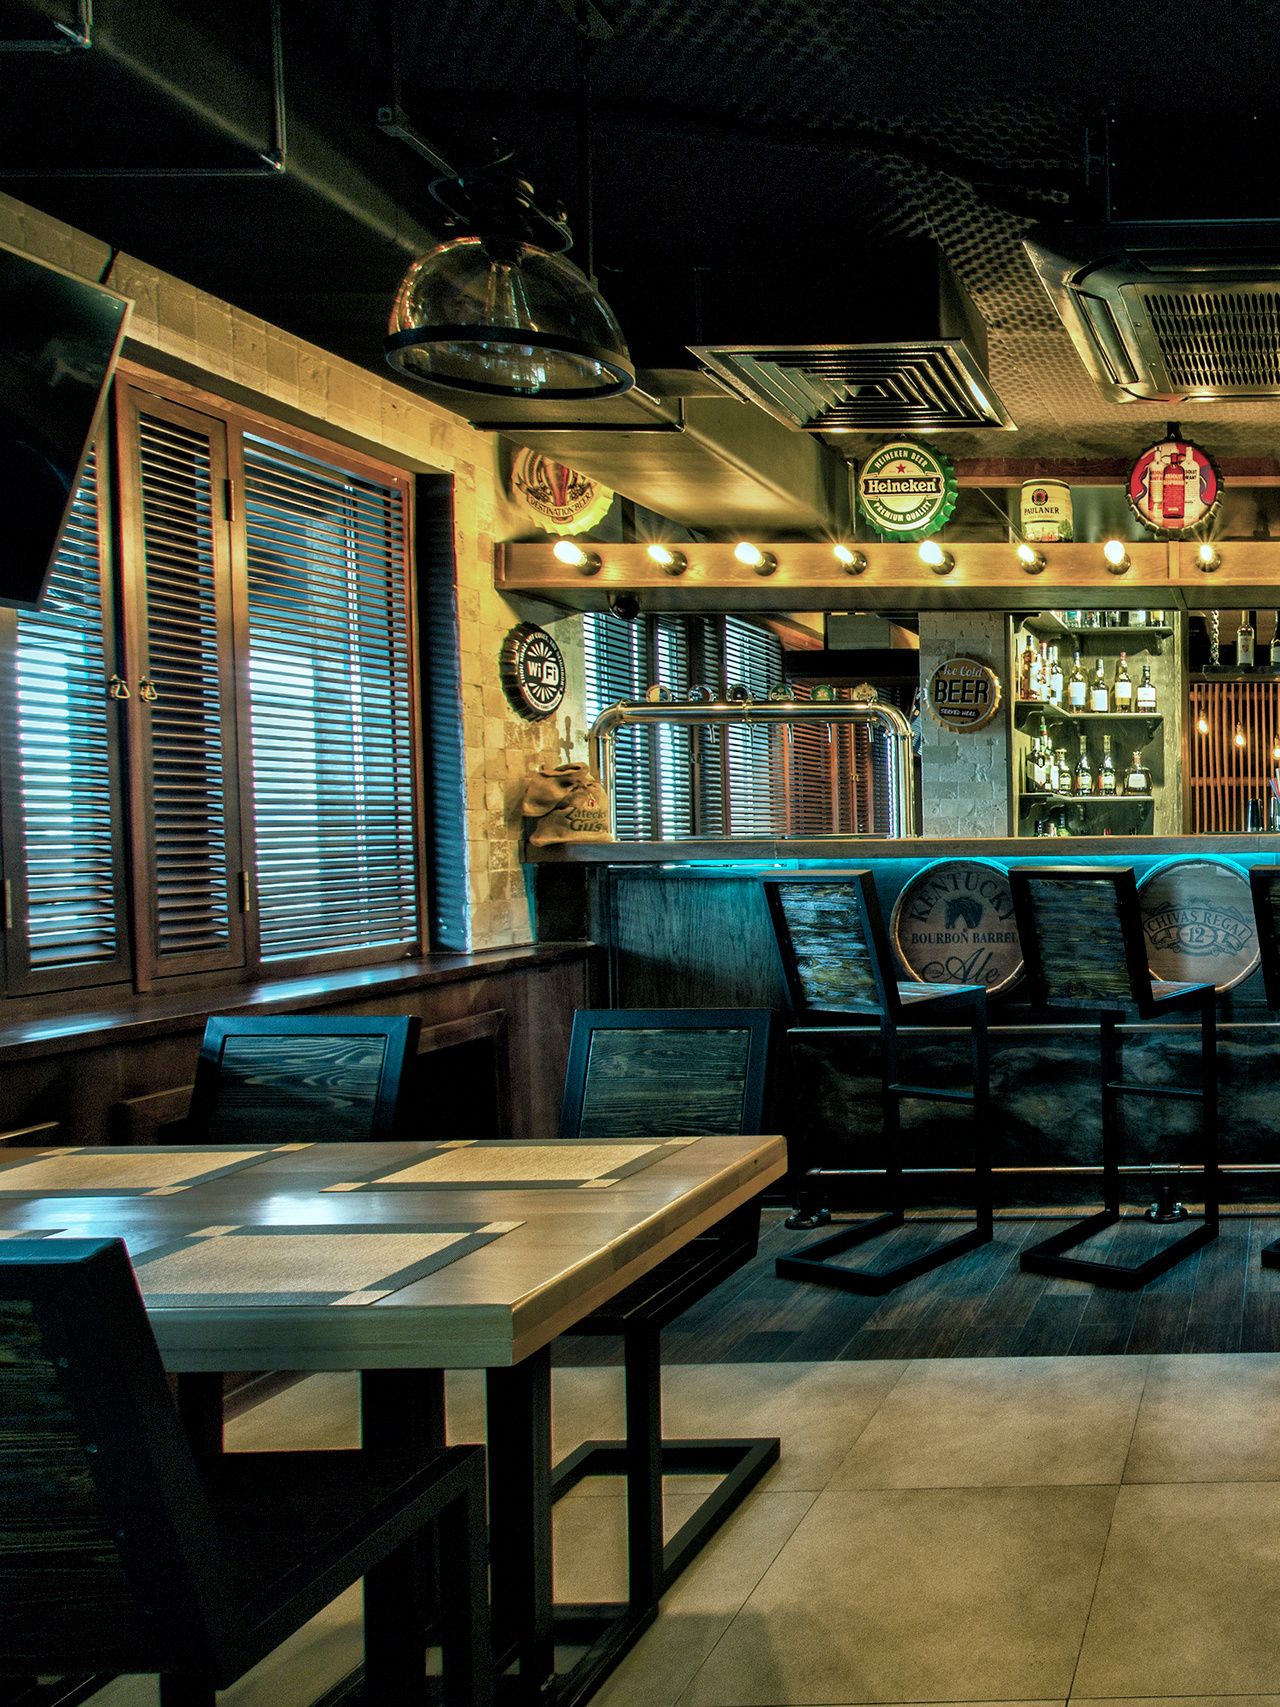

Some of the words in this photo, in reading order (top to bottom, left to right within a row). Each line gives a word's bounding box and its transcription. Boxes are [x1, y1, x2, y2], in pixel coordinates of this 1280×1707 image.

[874, 450, 908, 469] HEINEKEN
[910, 452, 928, 468] BEER
[867, 478, 937, 493] Heineken
[530, 496, 573, 516] DESTINATION
[573, 492, 592, 512] BEER
[873, 502, 904, 522] PREMIUM
[906, 500, 932, 522] QUALITY
[1024, 506, 1060, 516] PAULANER
[943, 664, 958, 676] Ice
[960, 666, 983, 678] Cold
[934, 679, 990, 704] BEER
[1147, 910, 1198, 932] CHIVAS
[1204, 912, 1248, 940] REGAL
[1188, 926, 1206, 943] 12
[911, 933, 968, 944] BOURBON
[922, 948, 998, 984] Ale
